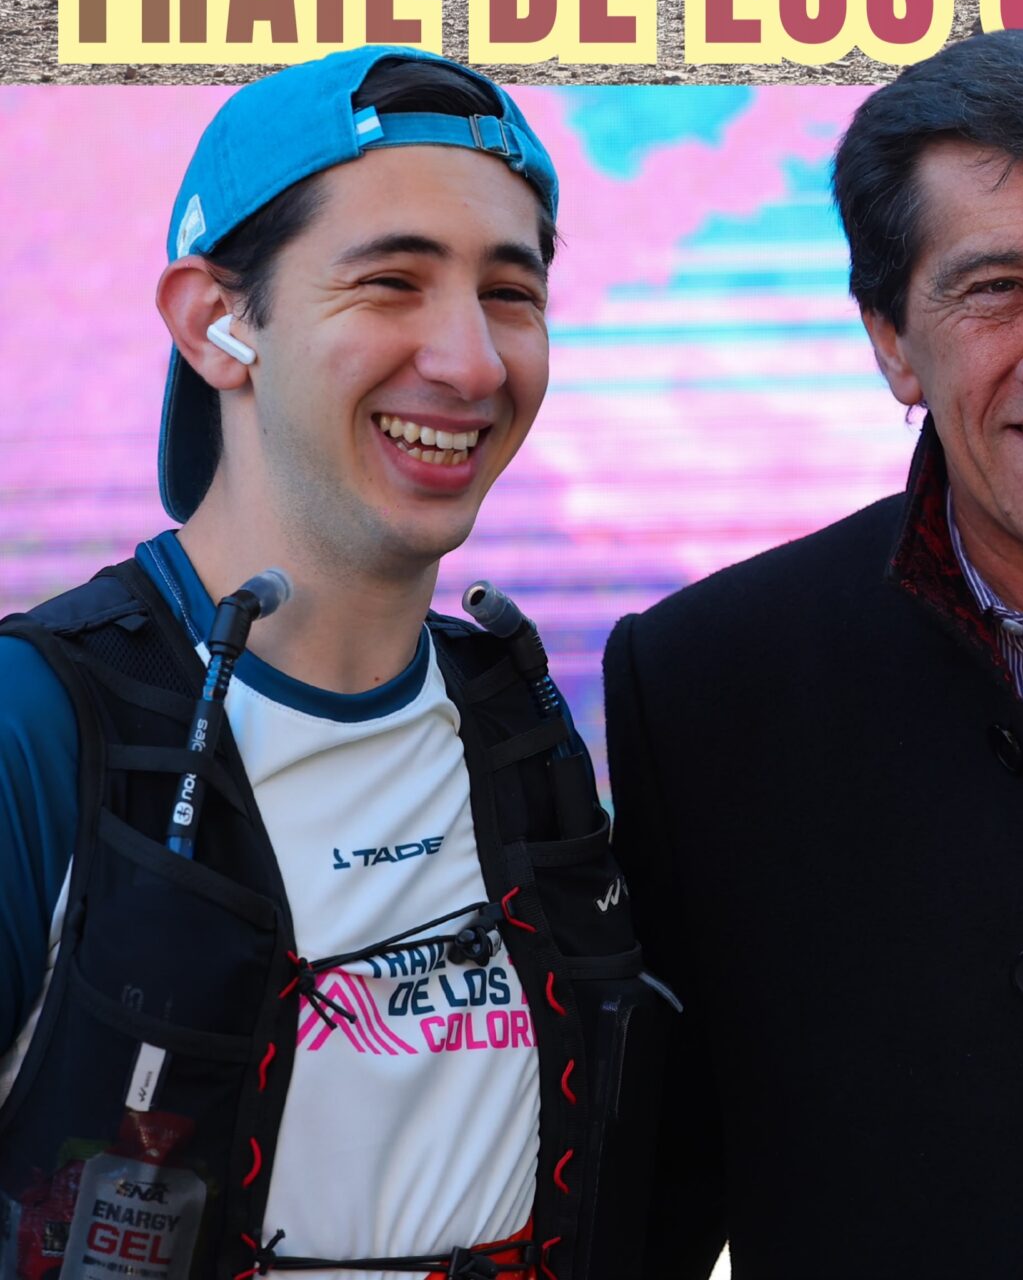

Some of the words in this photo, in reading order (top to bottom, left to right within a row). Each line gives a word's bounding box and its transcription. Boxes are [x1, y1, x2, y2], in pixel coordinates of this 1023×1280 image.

[352, 836, 445, 866] TADE
[388, 978, 435, 1016] DE
[439, 967, 511, 1008] LOS
[92, 1199, 181, 1232] ENARGY
[86, 1222, 171, 1265] GEL
